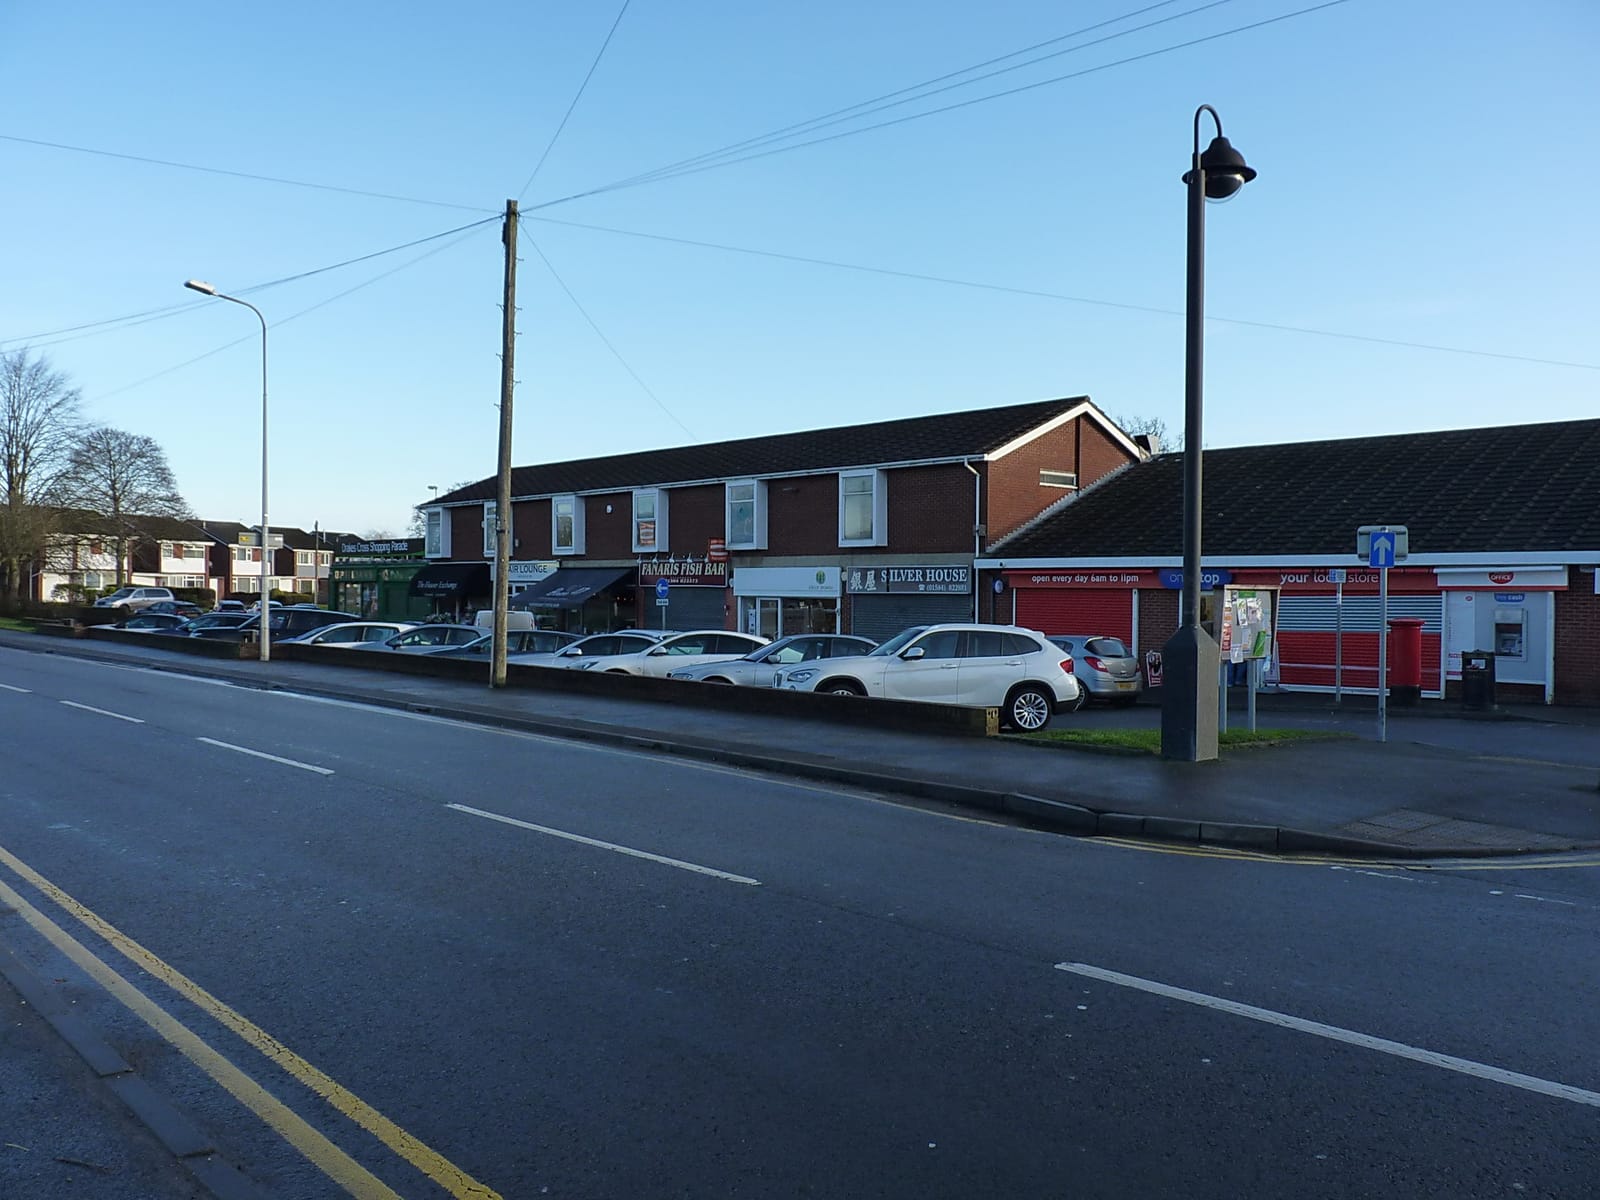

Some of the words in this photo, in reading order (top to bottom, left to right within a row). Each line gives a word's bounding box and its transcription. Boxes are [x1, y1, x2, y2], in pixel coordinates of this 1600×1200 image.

[342, 543, 356, 552] Drakes
[357, 543, 369, 552] Cross
[370, 542, 390, 553] Shopping
[391, 541, 408, 551] Parade
[520, 564, 547, 573] LOUNGE
[641, 562, 679, 576] FANARIS
[680, 562, 703, 576] FISH
[704, 562, 725, 576] BAR
[881, 569, 923, 582] SILVER
[926, 569, 967, 582] HOUSE
[1031, 574, 1050, 584] open
[1052, 575, 1073, 584] every
[1074, 573, 1089, 583] day
[1090, 574, 1107, 582] 6am
[1109, 574, 1119, 582] to
[1120, 573, 1139, 584] 11pm
[1280, 573, 1309, 585] your
[1348, 572, 1379, 583] store
